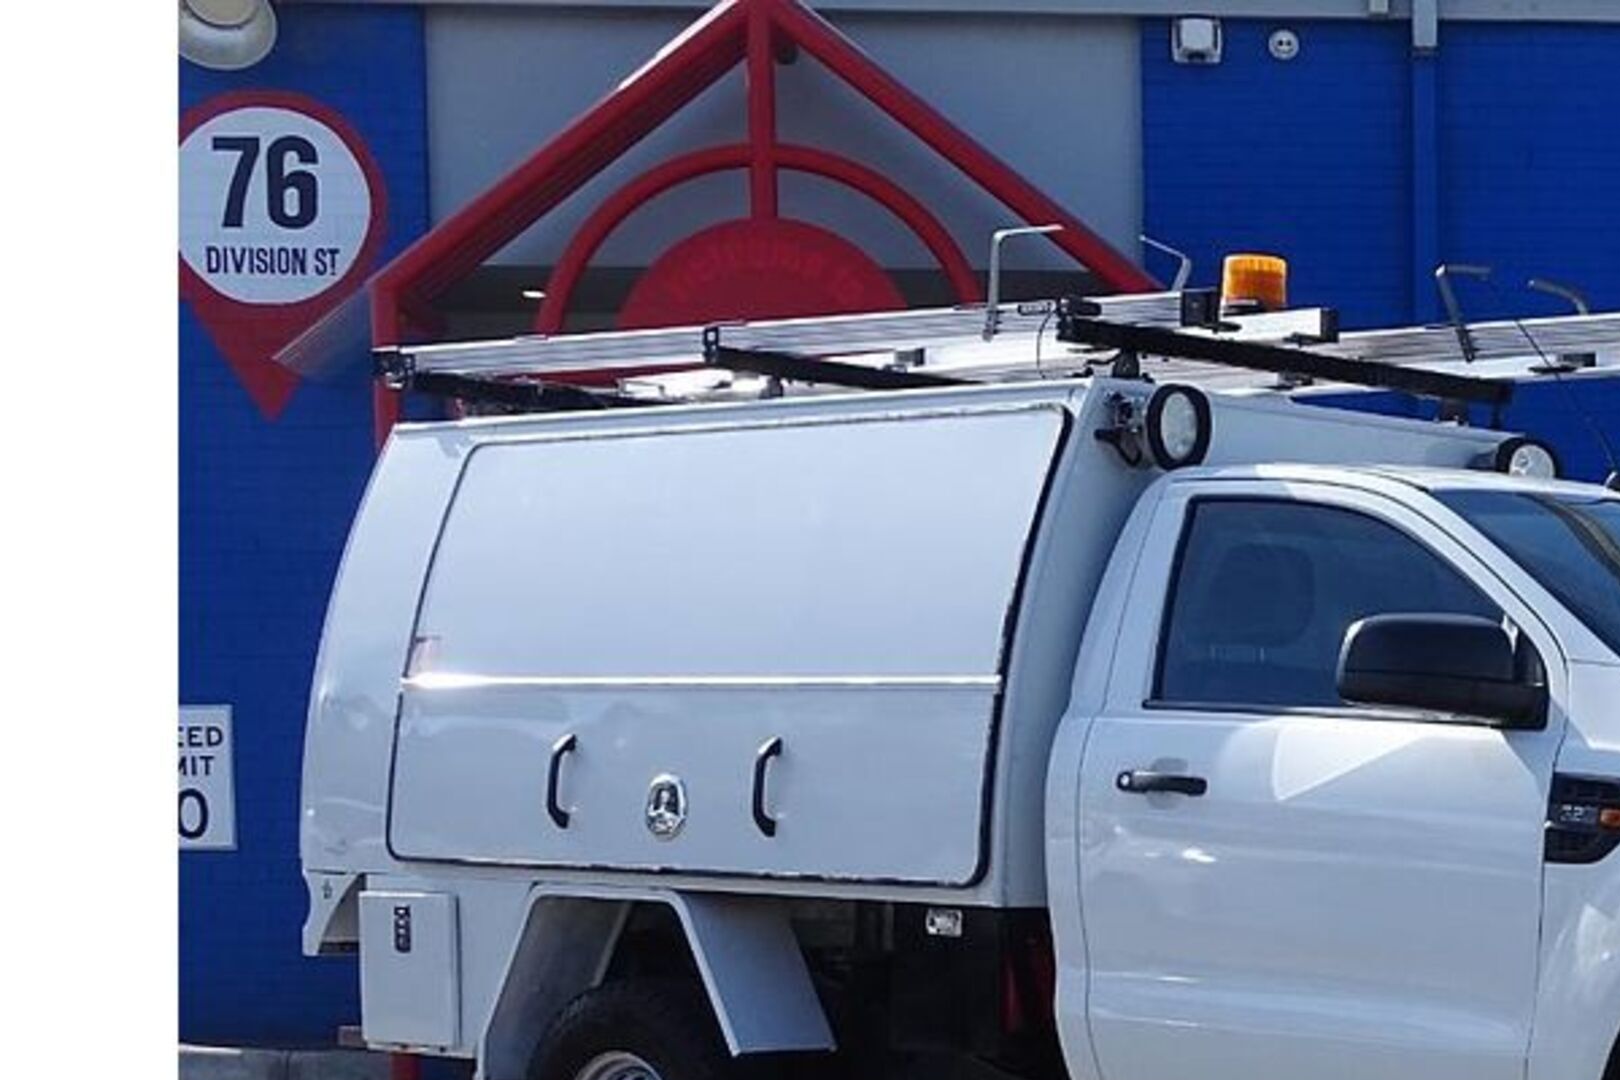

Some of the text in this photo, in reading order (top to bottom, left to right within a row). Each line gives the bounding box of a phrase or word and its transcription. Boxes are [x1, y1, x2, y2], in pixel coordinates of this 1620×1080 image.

[212, 135, 318, 229] 76
[206, 246, 340, 276] DIVISION ST
